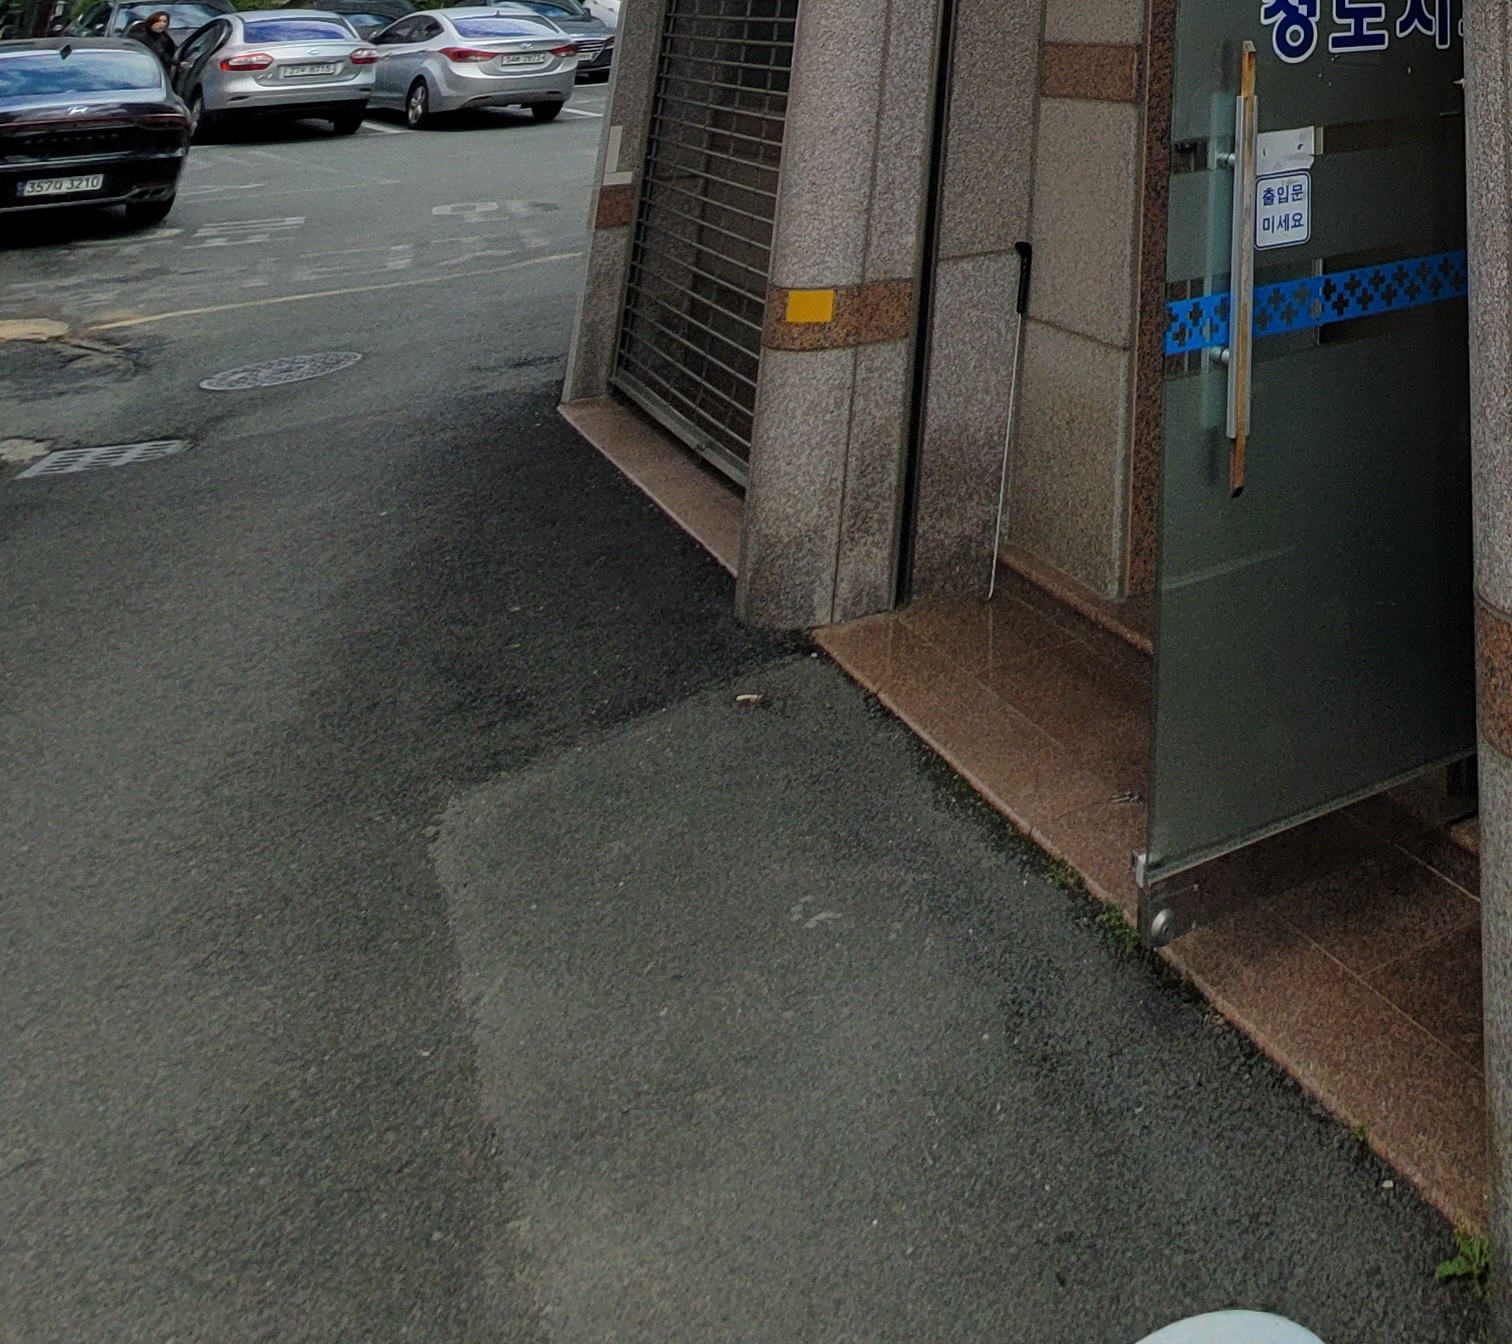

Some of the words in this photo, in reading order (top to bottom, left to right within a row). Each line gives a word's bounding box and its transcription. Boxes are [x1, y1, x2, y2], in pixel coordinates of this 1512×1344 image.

[66, 176, 100, 190] 3210
[1261, 183, 1304, 207] 출입문
[1261, 212, 1305, 234] 미세요
